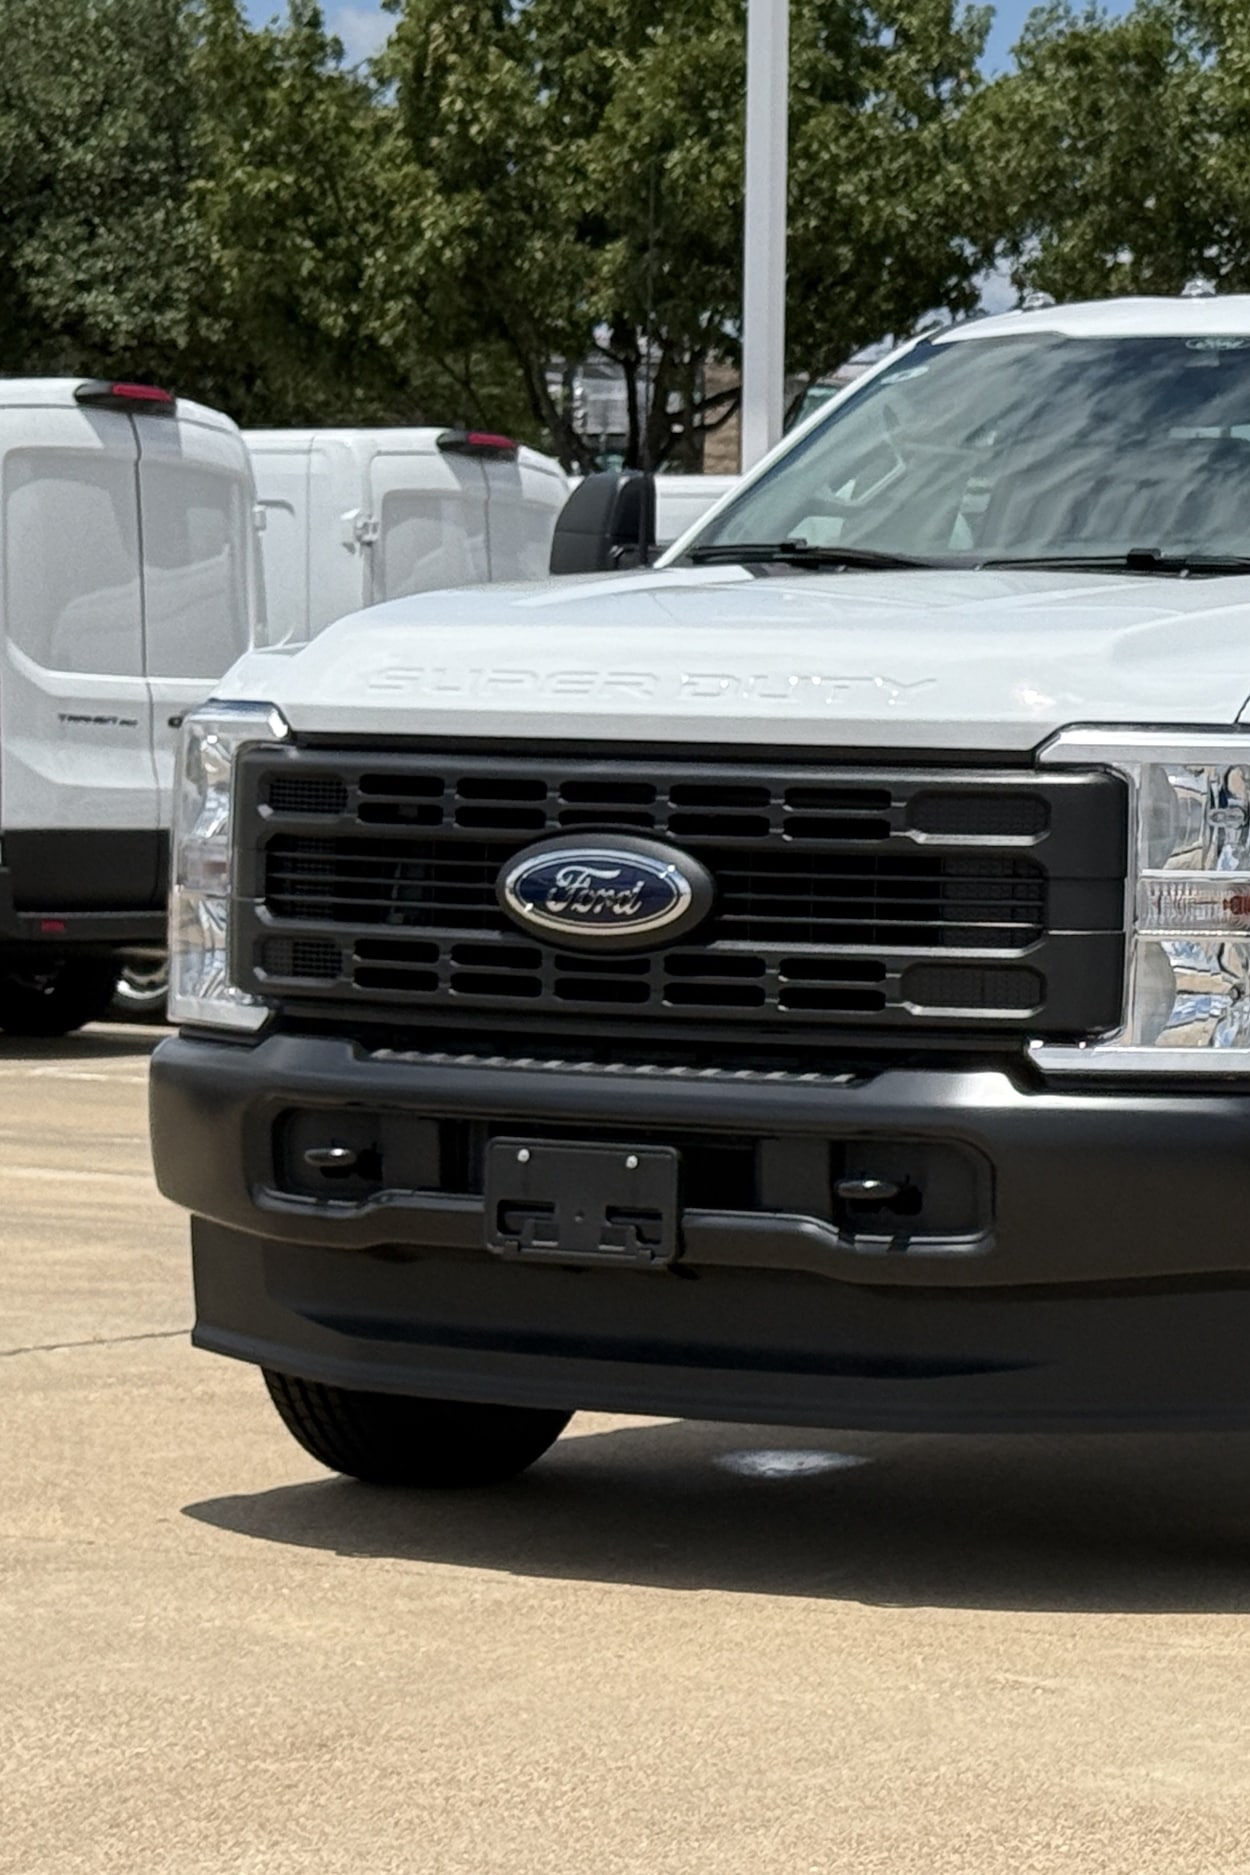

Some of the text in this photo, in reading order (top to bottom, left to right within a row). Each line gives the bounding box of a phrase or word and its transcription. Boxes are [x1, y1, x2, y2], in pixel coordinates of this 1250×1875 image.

[367, 667, 938, 705] SUPER DUTY
[545, 864, 646, 916] Ford
